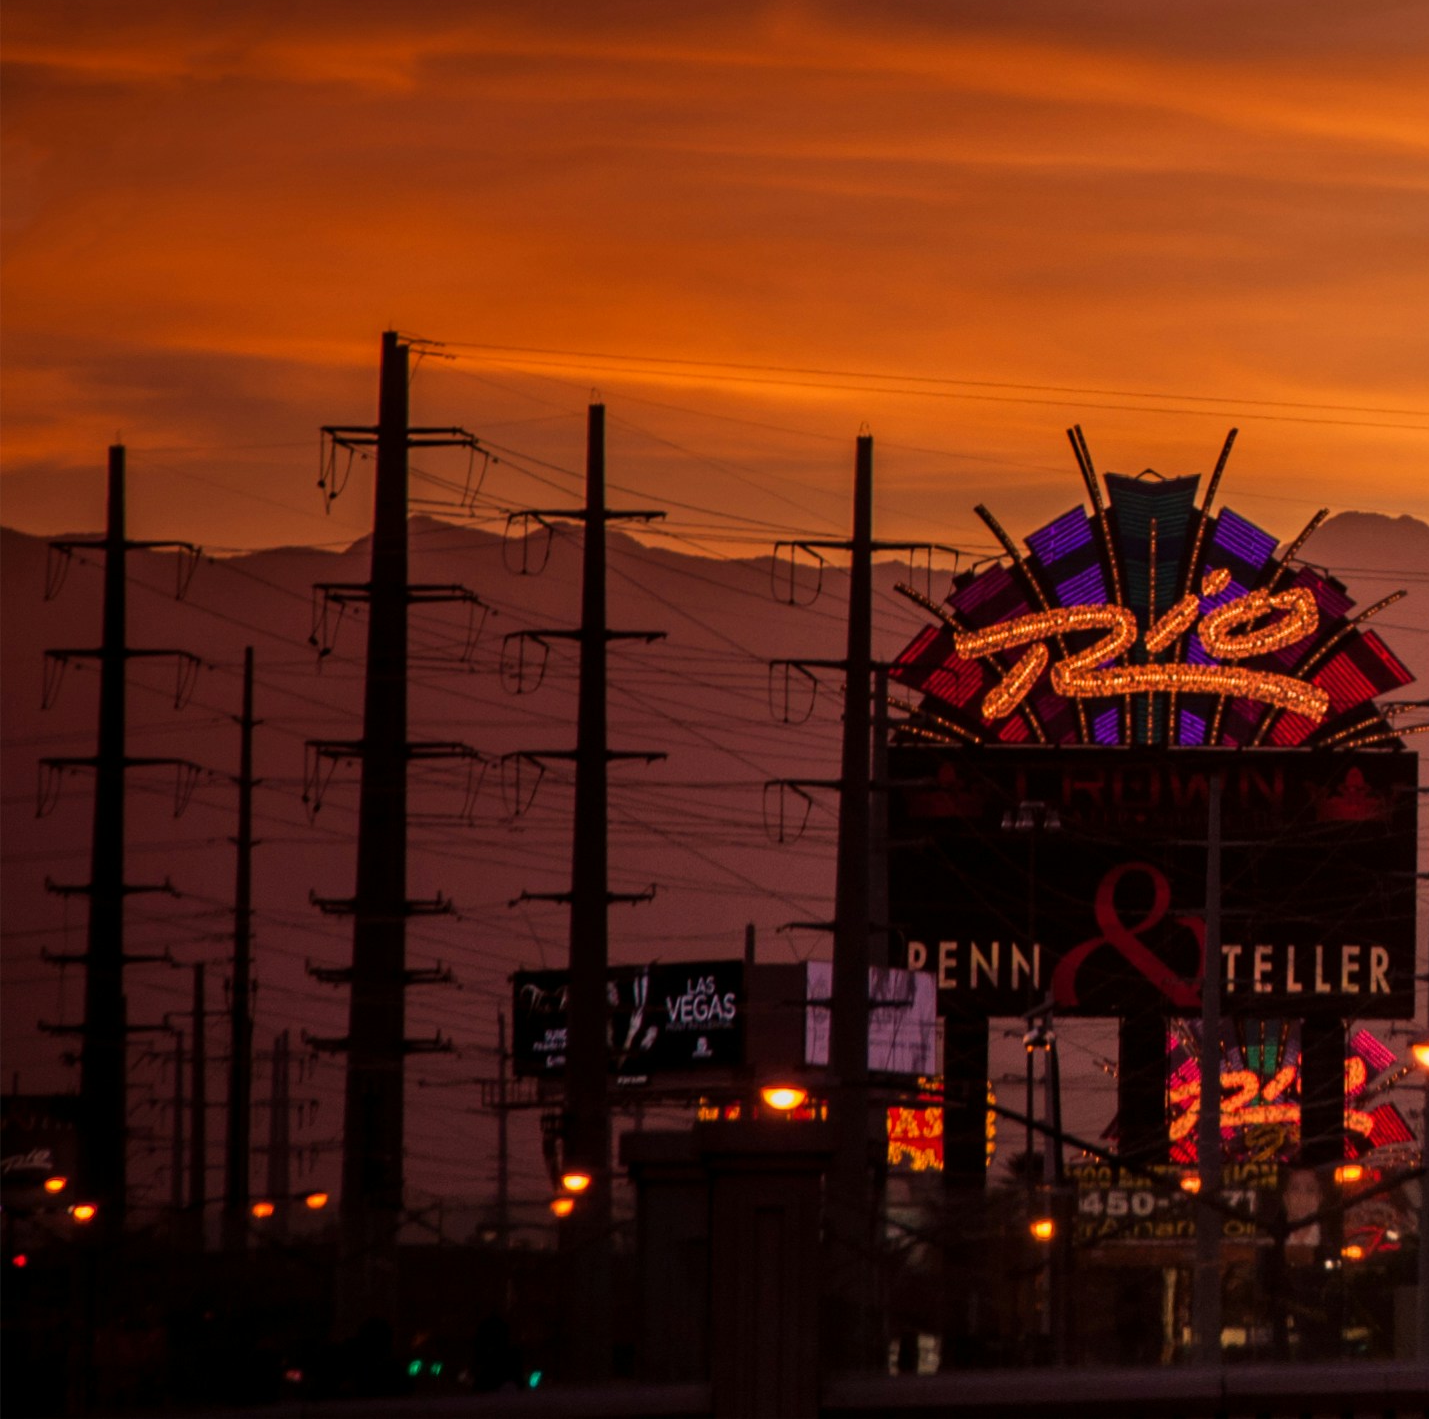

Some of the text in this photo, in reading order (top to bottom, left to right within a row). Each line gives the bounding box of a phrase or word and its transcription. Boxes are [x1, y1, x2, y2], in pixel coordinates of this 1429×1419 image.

[953, 567, 1330, 724] Rio
[907, 860, 1392, 1009] PENN & TELLER
[665, 992, 737, 1023] VEGAS
[686, 975, 716, 996] LAS
